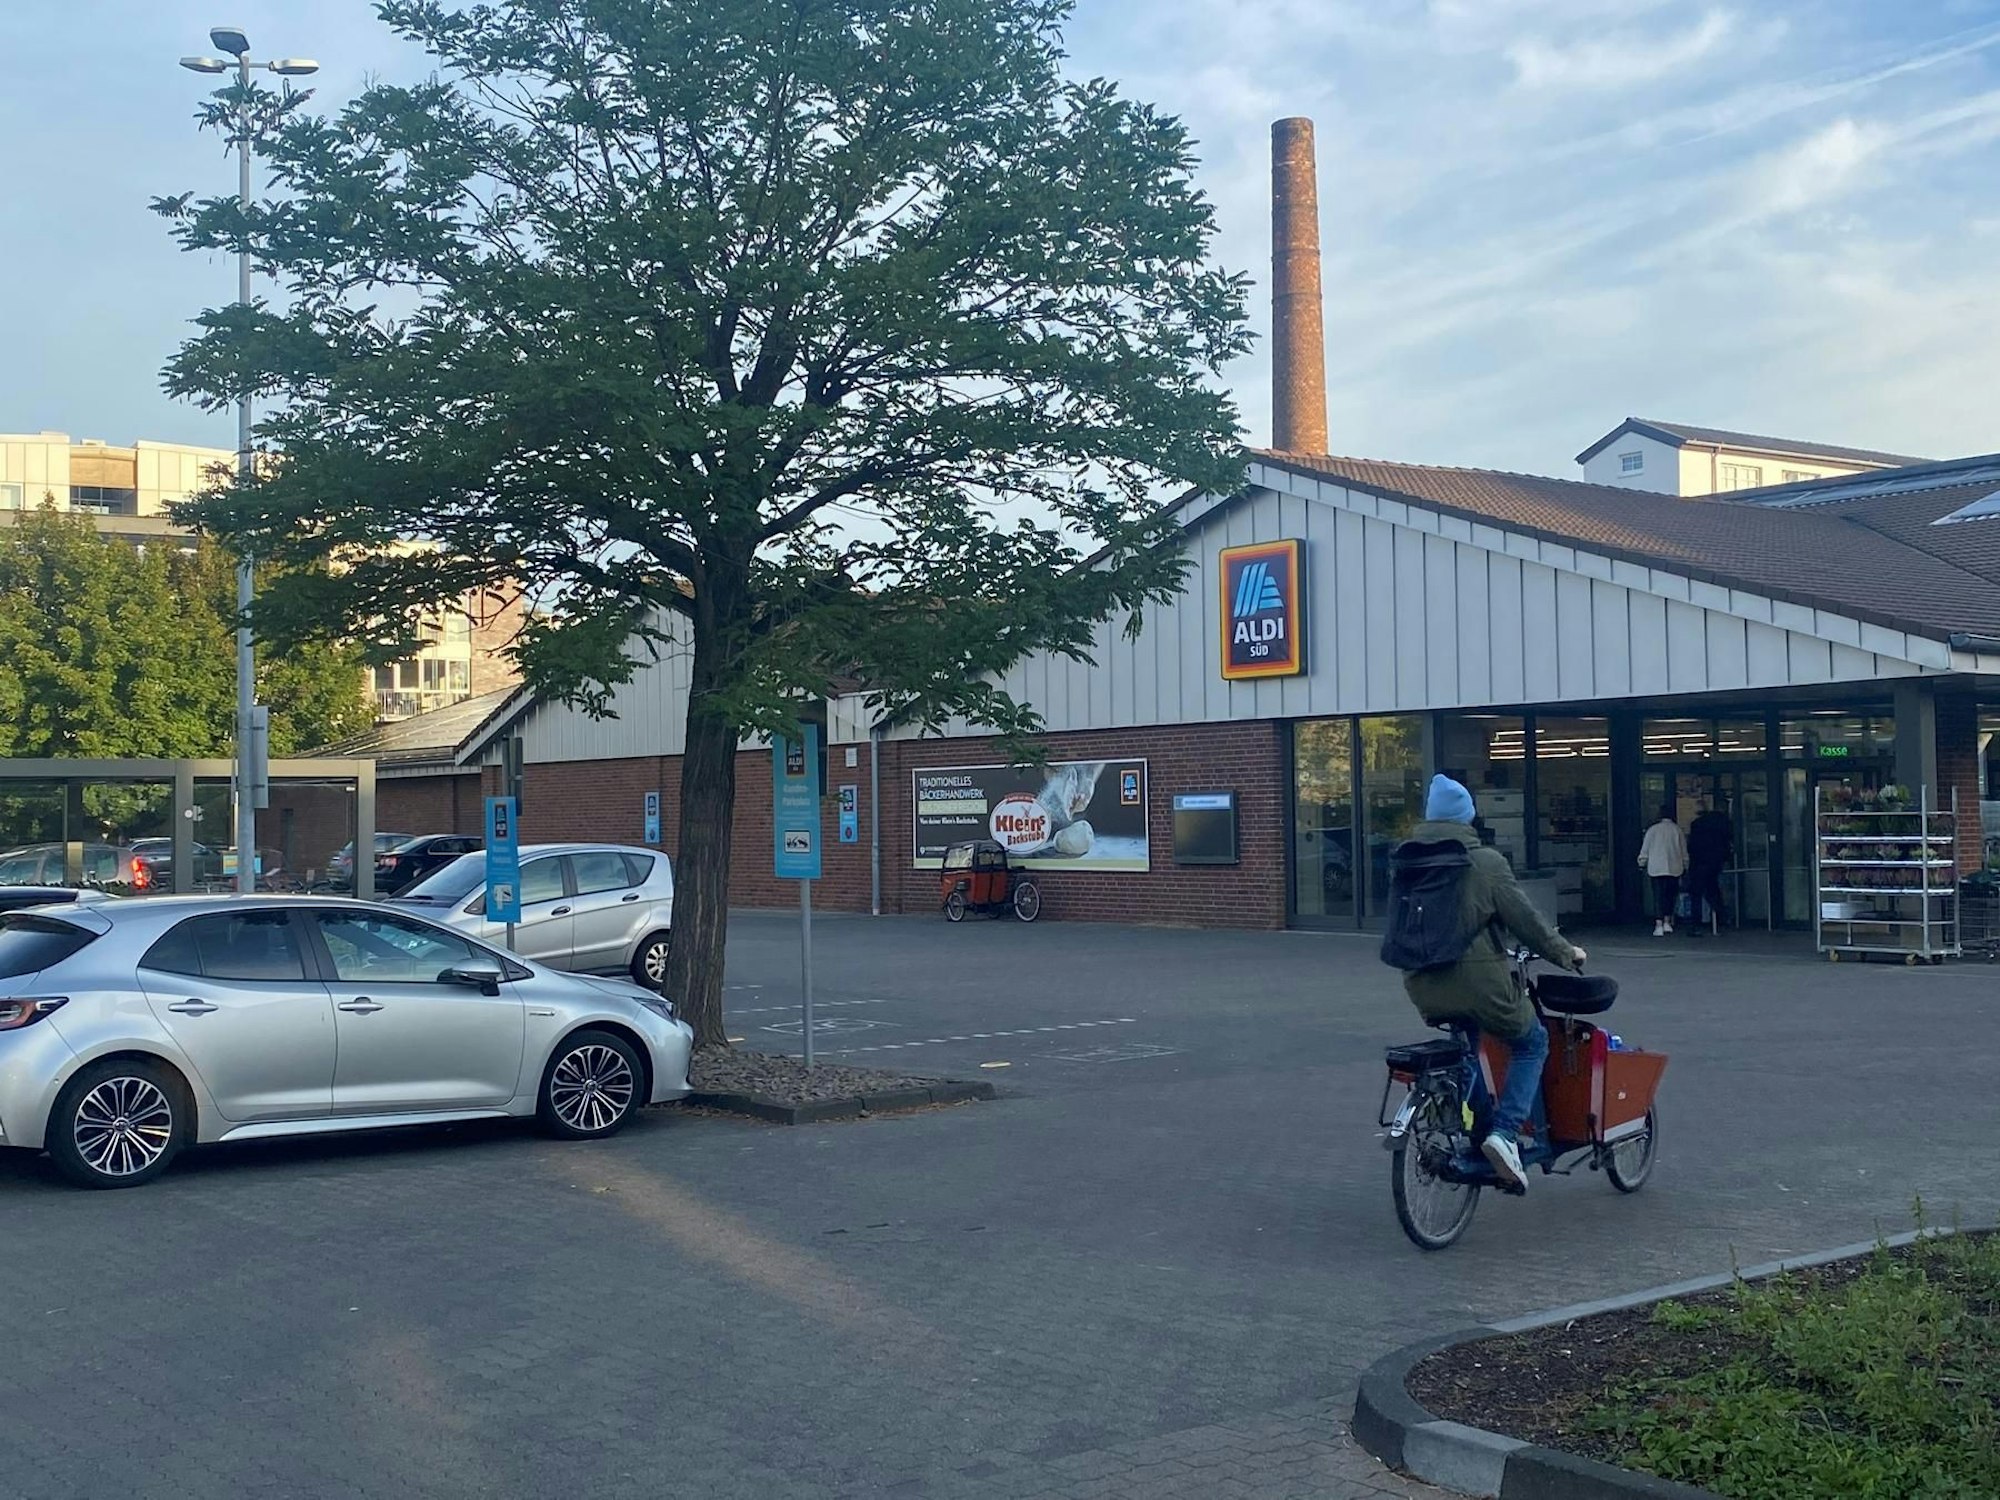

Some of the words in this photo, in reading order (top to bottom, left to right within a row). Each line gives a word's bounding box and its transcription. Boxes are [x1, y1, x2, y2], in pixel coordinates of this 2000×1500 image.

[1234, 617, 1284, 644] ALDI
[1250, 643, 1269, 657] SÜD
[1820, 746, 1847, 757] Kasse
[919, 775, 972, 788] TRADITIONELLES
[919, 788, 984, 799] BÄCKERHANDWERK
[1007, 831, 1045, 846] Backstube
